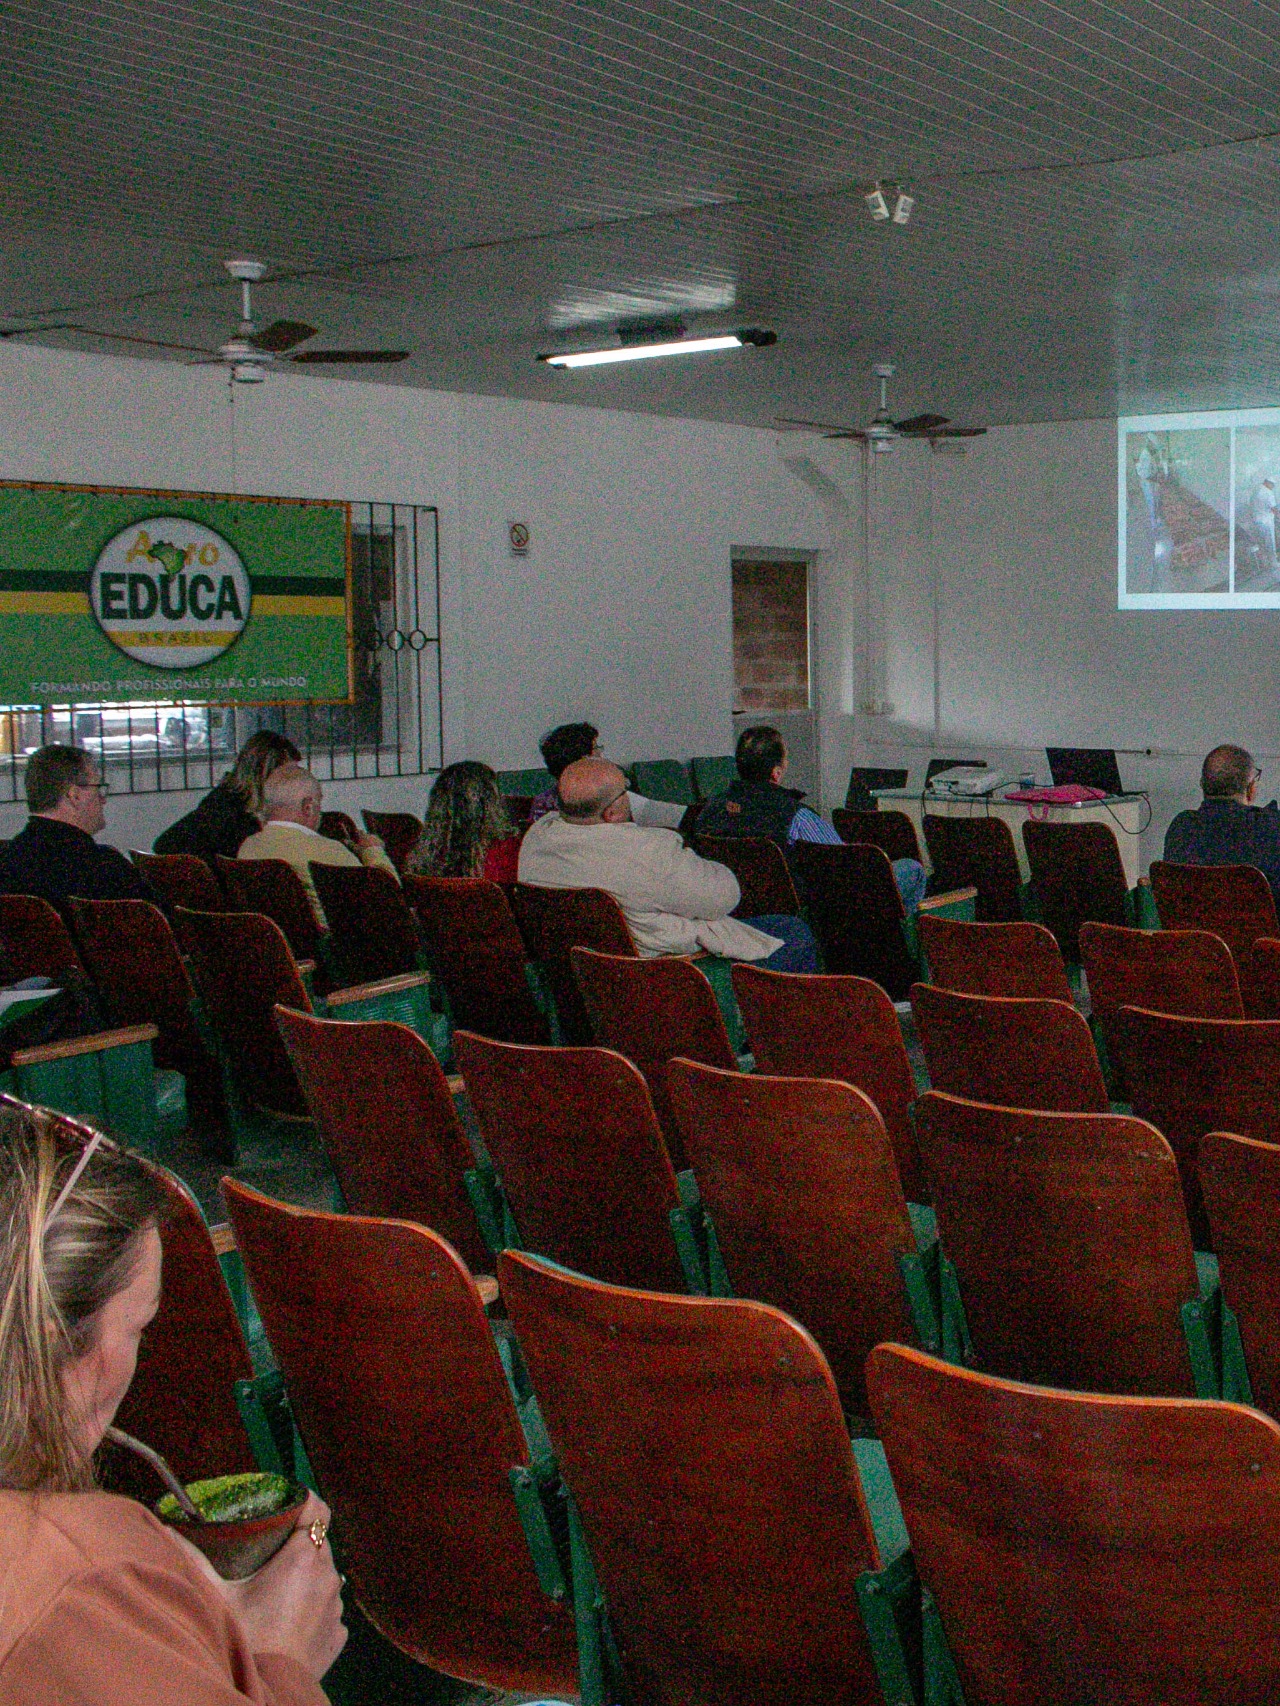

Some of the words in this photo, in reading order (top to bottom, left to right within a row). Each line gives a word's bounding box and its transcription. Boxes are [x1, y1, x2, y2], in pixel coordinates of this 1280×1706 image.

[100, 572, 243, 621] EDUCA
[31, 681, 111, 694] FORMANDO
[215, 678, 243, 688] PARA
[261, 676, 307, 687] MUNDO
